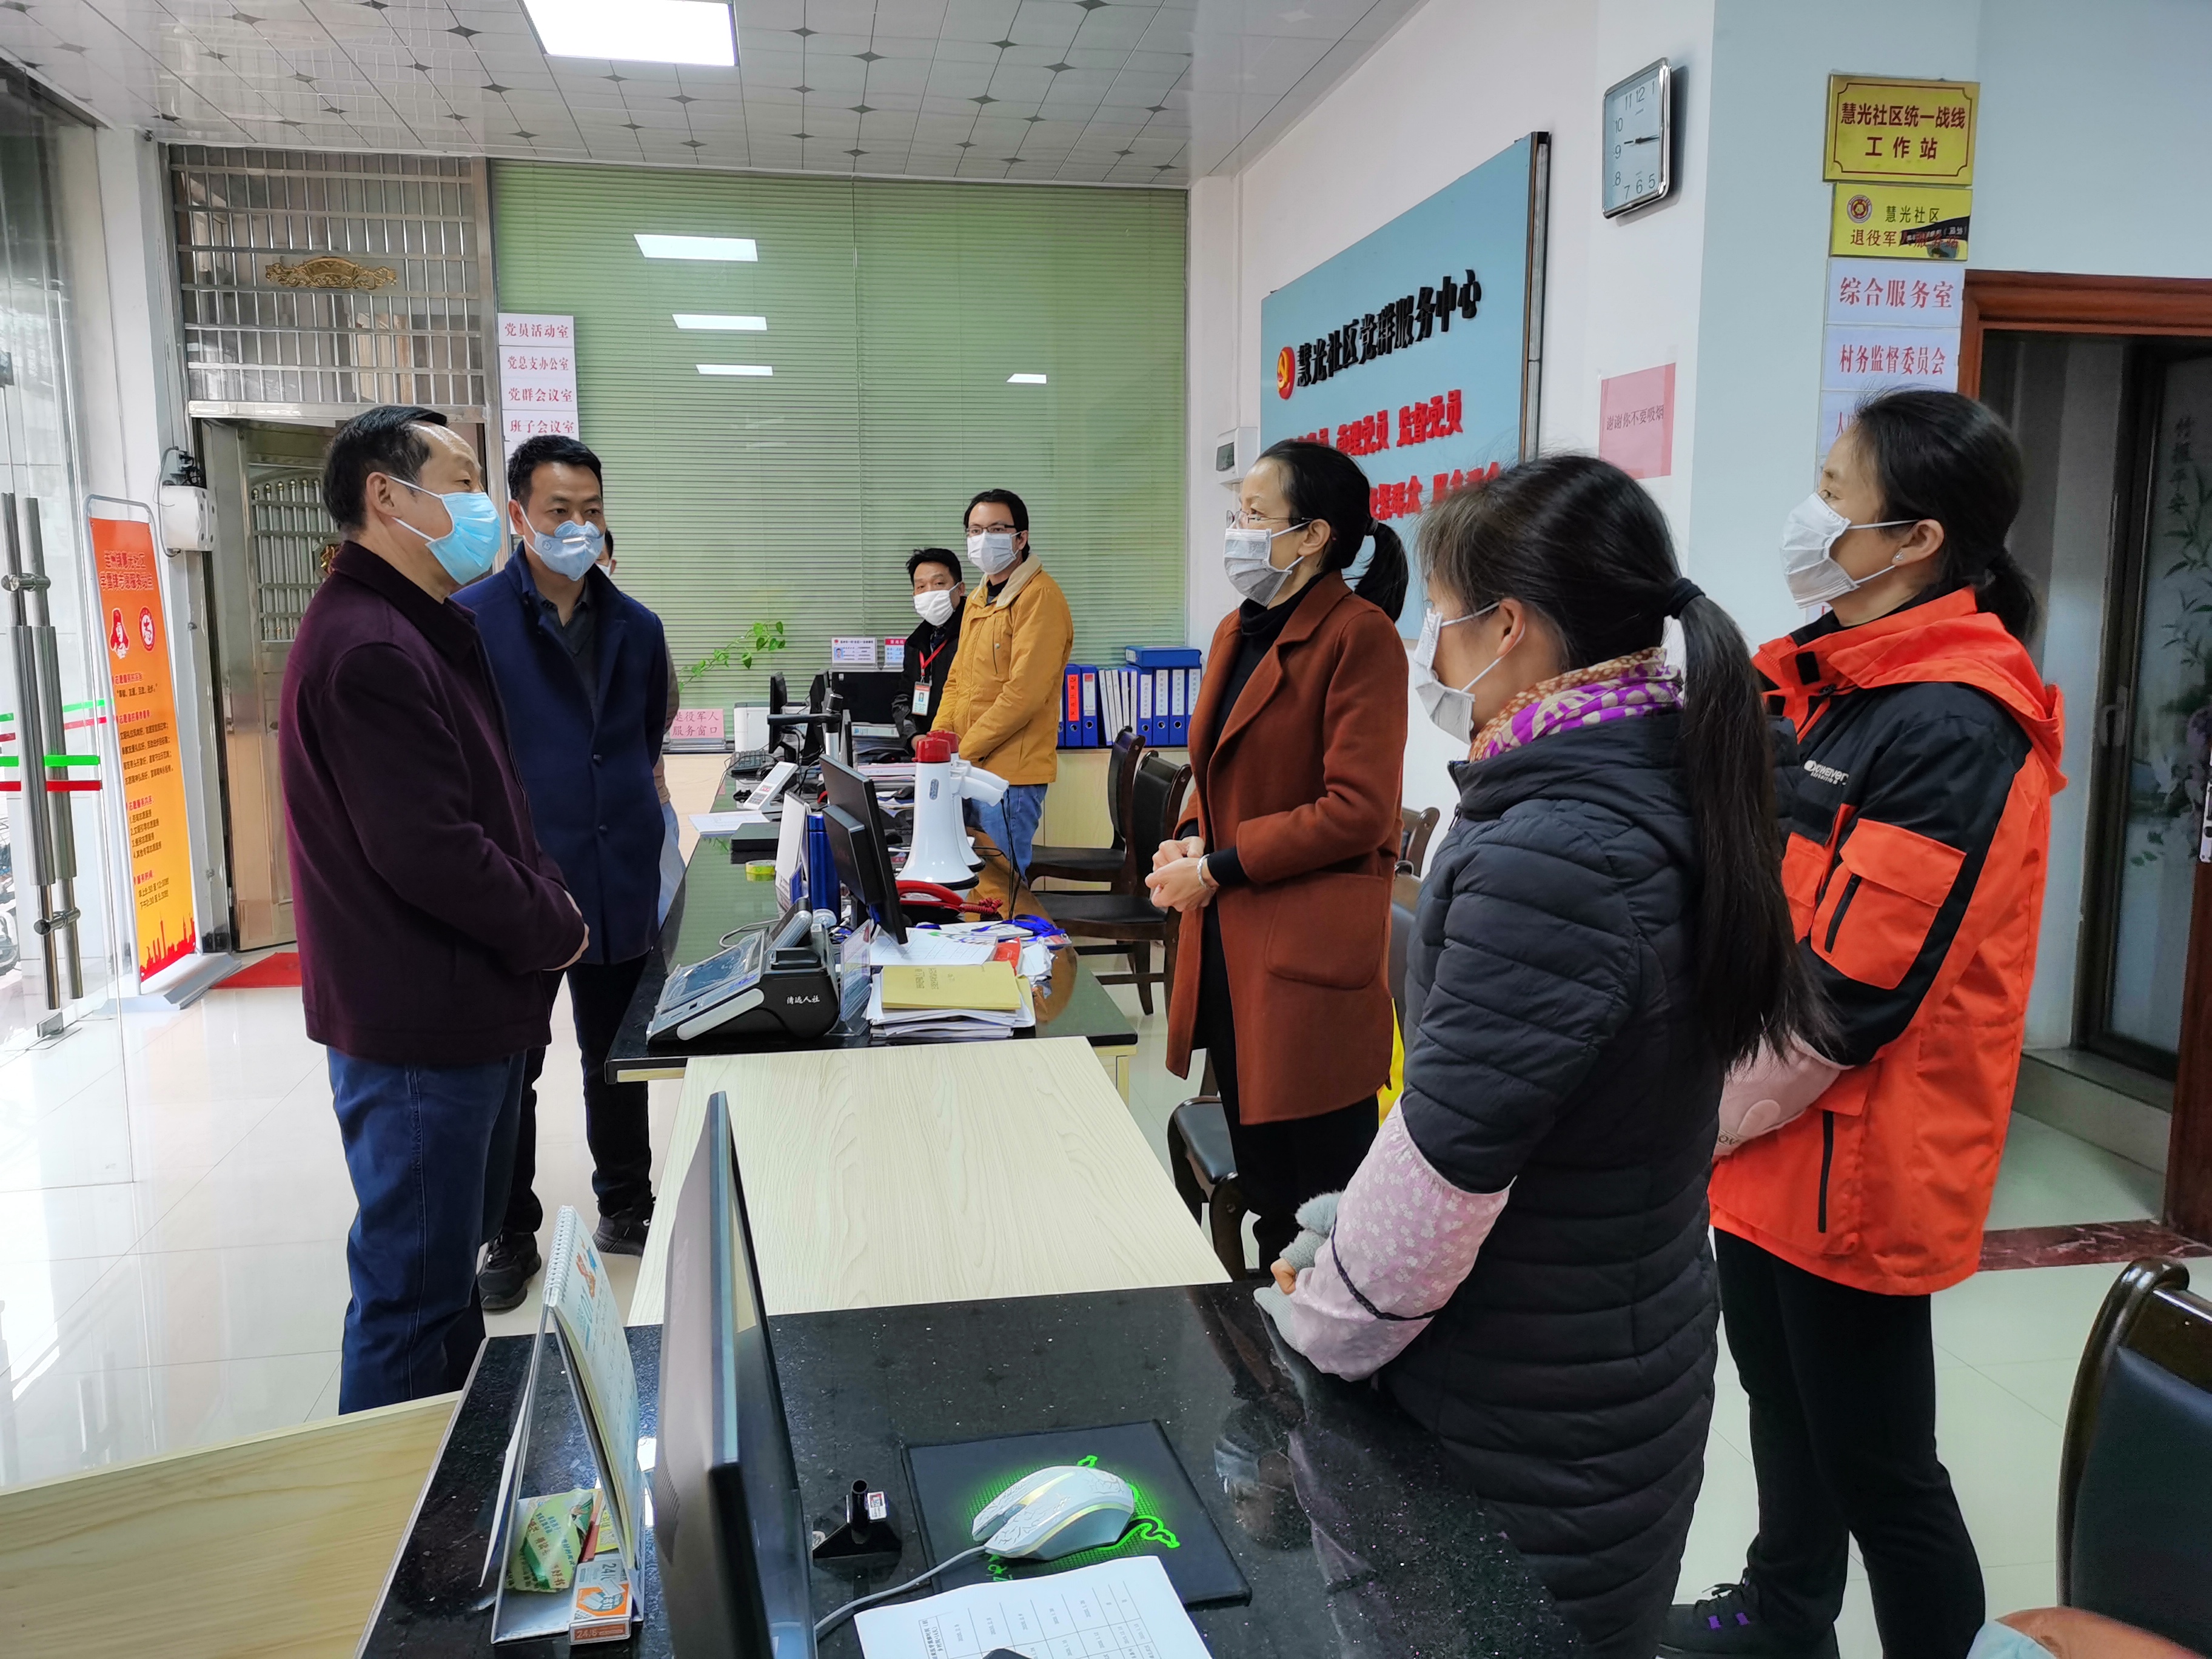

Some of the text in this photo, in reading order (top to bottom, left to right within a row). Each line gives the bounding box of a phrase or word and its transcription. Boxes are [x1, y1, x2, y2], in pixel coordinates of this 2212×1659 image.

[1635, 86, 1645, 102] 12
[1651, 81, 1655, 94] 1
[1625, 95, 1632, 110] 11
[1841, 102, 1966, 129] 慧光社区统一战线
[1615, 117, 1623, 132] 10
[1615, 144, 1621, 159] 9
[1865, 136, 1939, 160] 工作站
[1615, 172, 1621, 186] 8
[1636, 179, 1643, 193] 6
[1648, 173, 1655, 189] 5
[1624, 185, 1630, 200] 7
[1885, 205, 1941, 224] 慧光社区
[1840, 276, 1954, 309] 综合服务室
[504, 322, 569, 338] 党员活动室
[1296, 269, 1482, 387] 慧光社区党群服务中心
[507, 355, 569, 371] 党总支办公室
[1839, 344, 1946, 375] 村务监督委员会
[508, 387, 573, 403] 党群会议室
[1396, 389, 1463, 447] 监督党员
[509, 419, 575, 434] 班子会议室
[671, 725, 718, 737] 服务窗口
